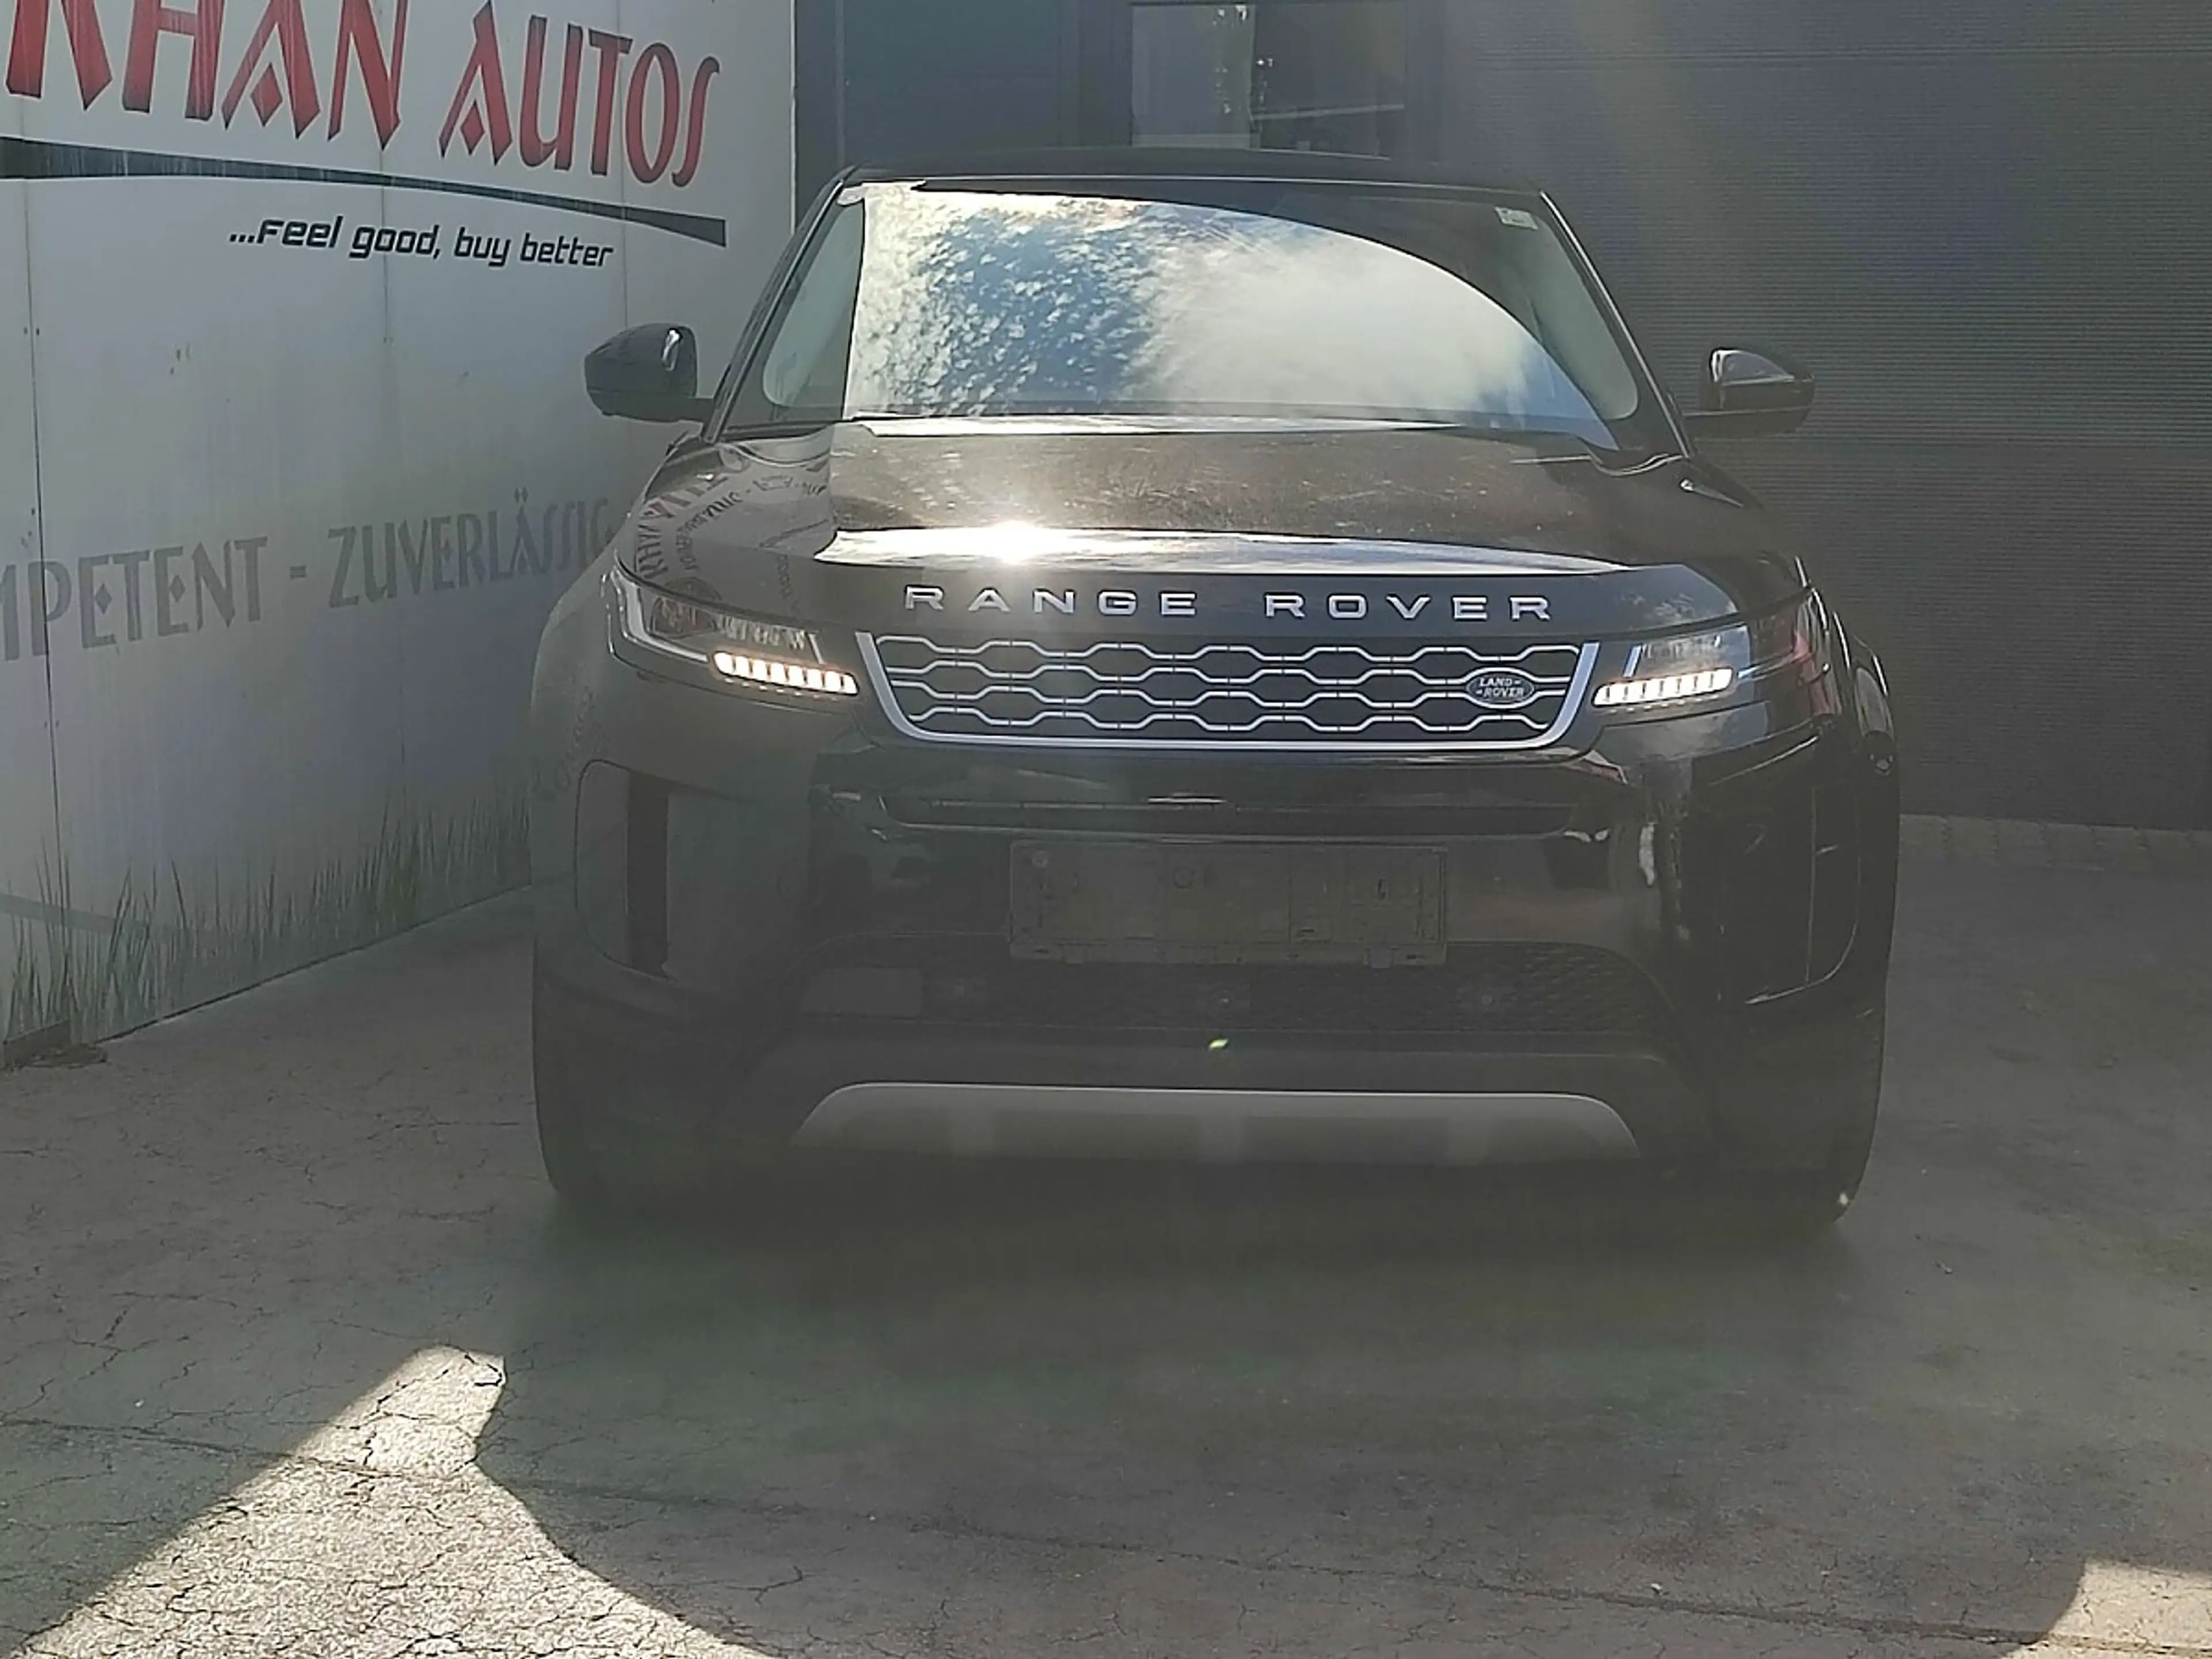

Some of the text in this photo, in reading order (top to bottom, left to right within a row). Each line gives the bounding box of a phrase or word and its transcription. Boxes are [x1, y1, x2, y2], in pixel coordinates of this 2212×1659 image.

[438, 0, 720, 188] AUTOS
[348, 225, 441, 259] good,
[454, 226, 512, 267] buy
[520, 232, 615, 267] better
[904, 585, 1550, 620] RANGE ROVER
